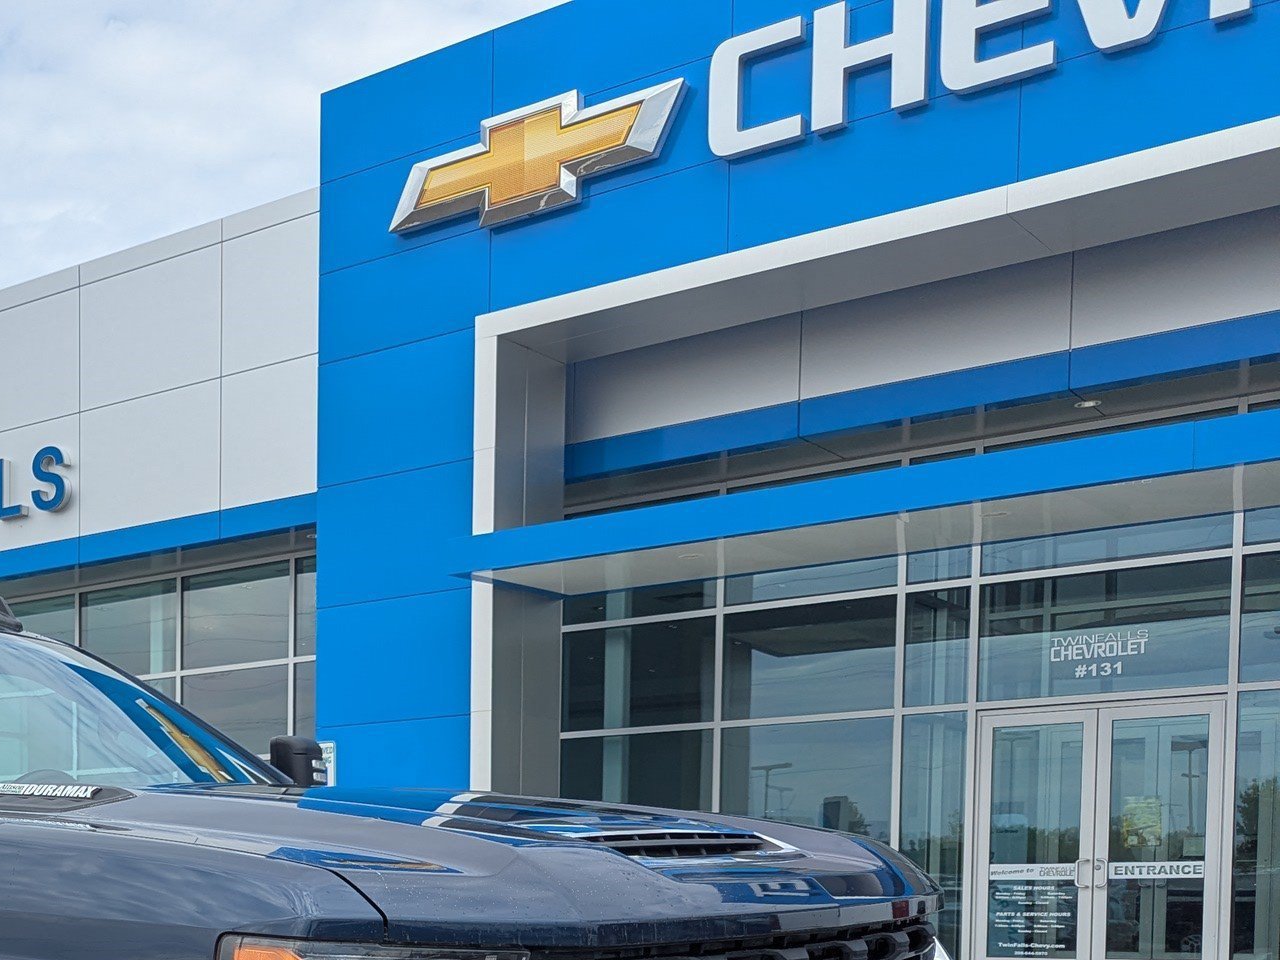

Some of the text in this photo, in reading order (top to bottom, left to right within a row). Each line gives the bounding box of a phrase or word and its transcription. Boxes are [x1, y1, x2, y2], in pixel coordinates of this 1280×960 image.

[1051, 629, 1149, 647] TWINFALLS
[1050, 638, 1149, 662] CHEVROLET
[1074, 661, 1122, 678] #131
[22, 784, 99, 799] DURAMAX
[1113, 864, 1203, 876] ENTRANCE
